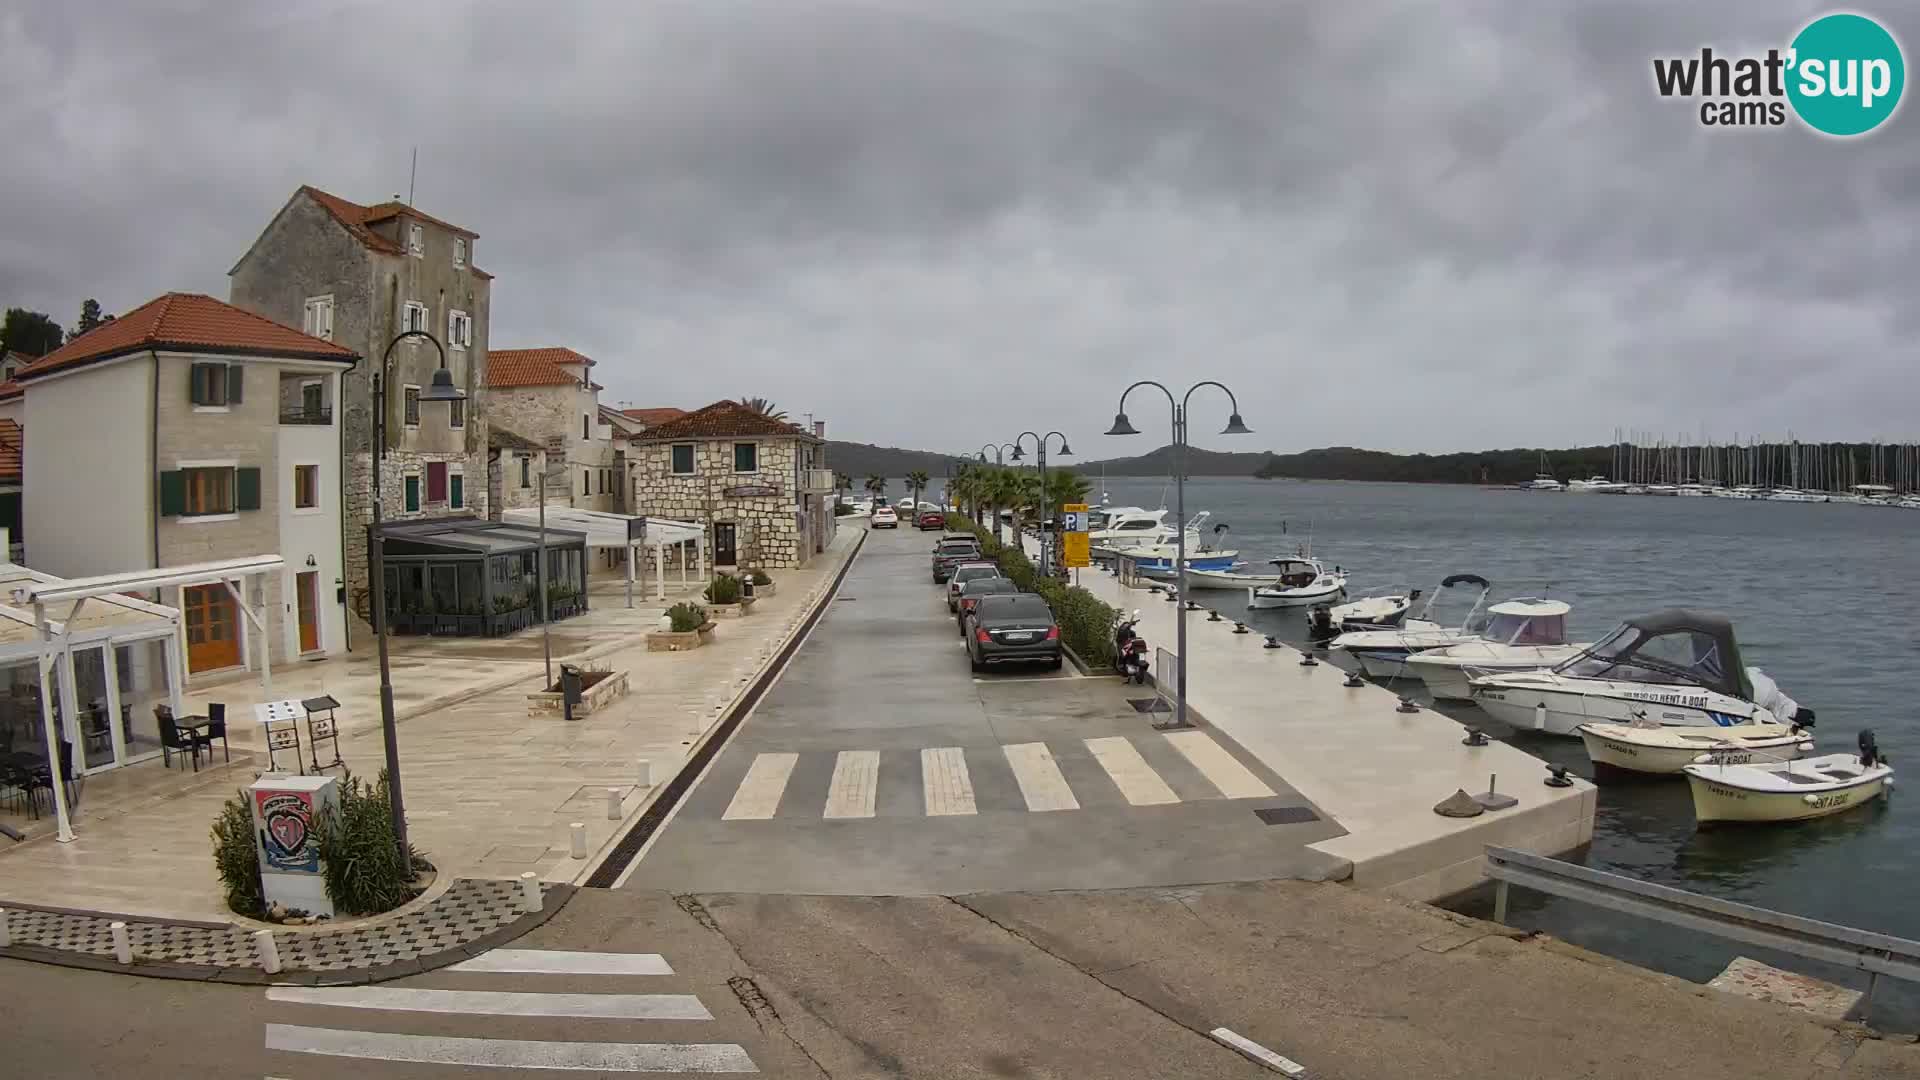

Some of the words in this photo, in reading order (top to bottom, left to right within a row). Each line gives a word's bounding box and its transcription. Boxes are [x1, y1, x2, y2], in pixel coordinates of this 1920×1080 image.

[1065, 514, 1077, 530] P
[1660, 694, 1681, 706] RENT
[1688, 696, 1709, 709] BOAT
